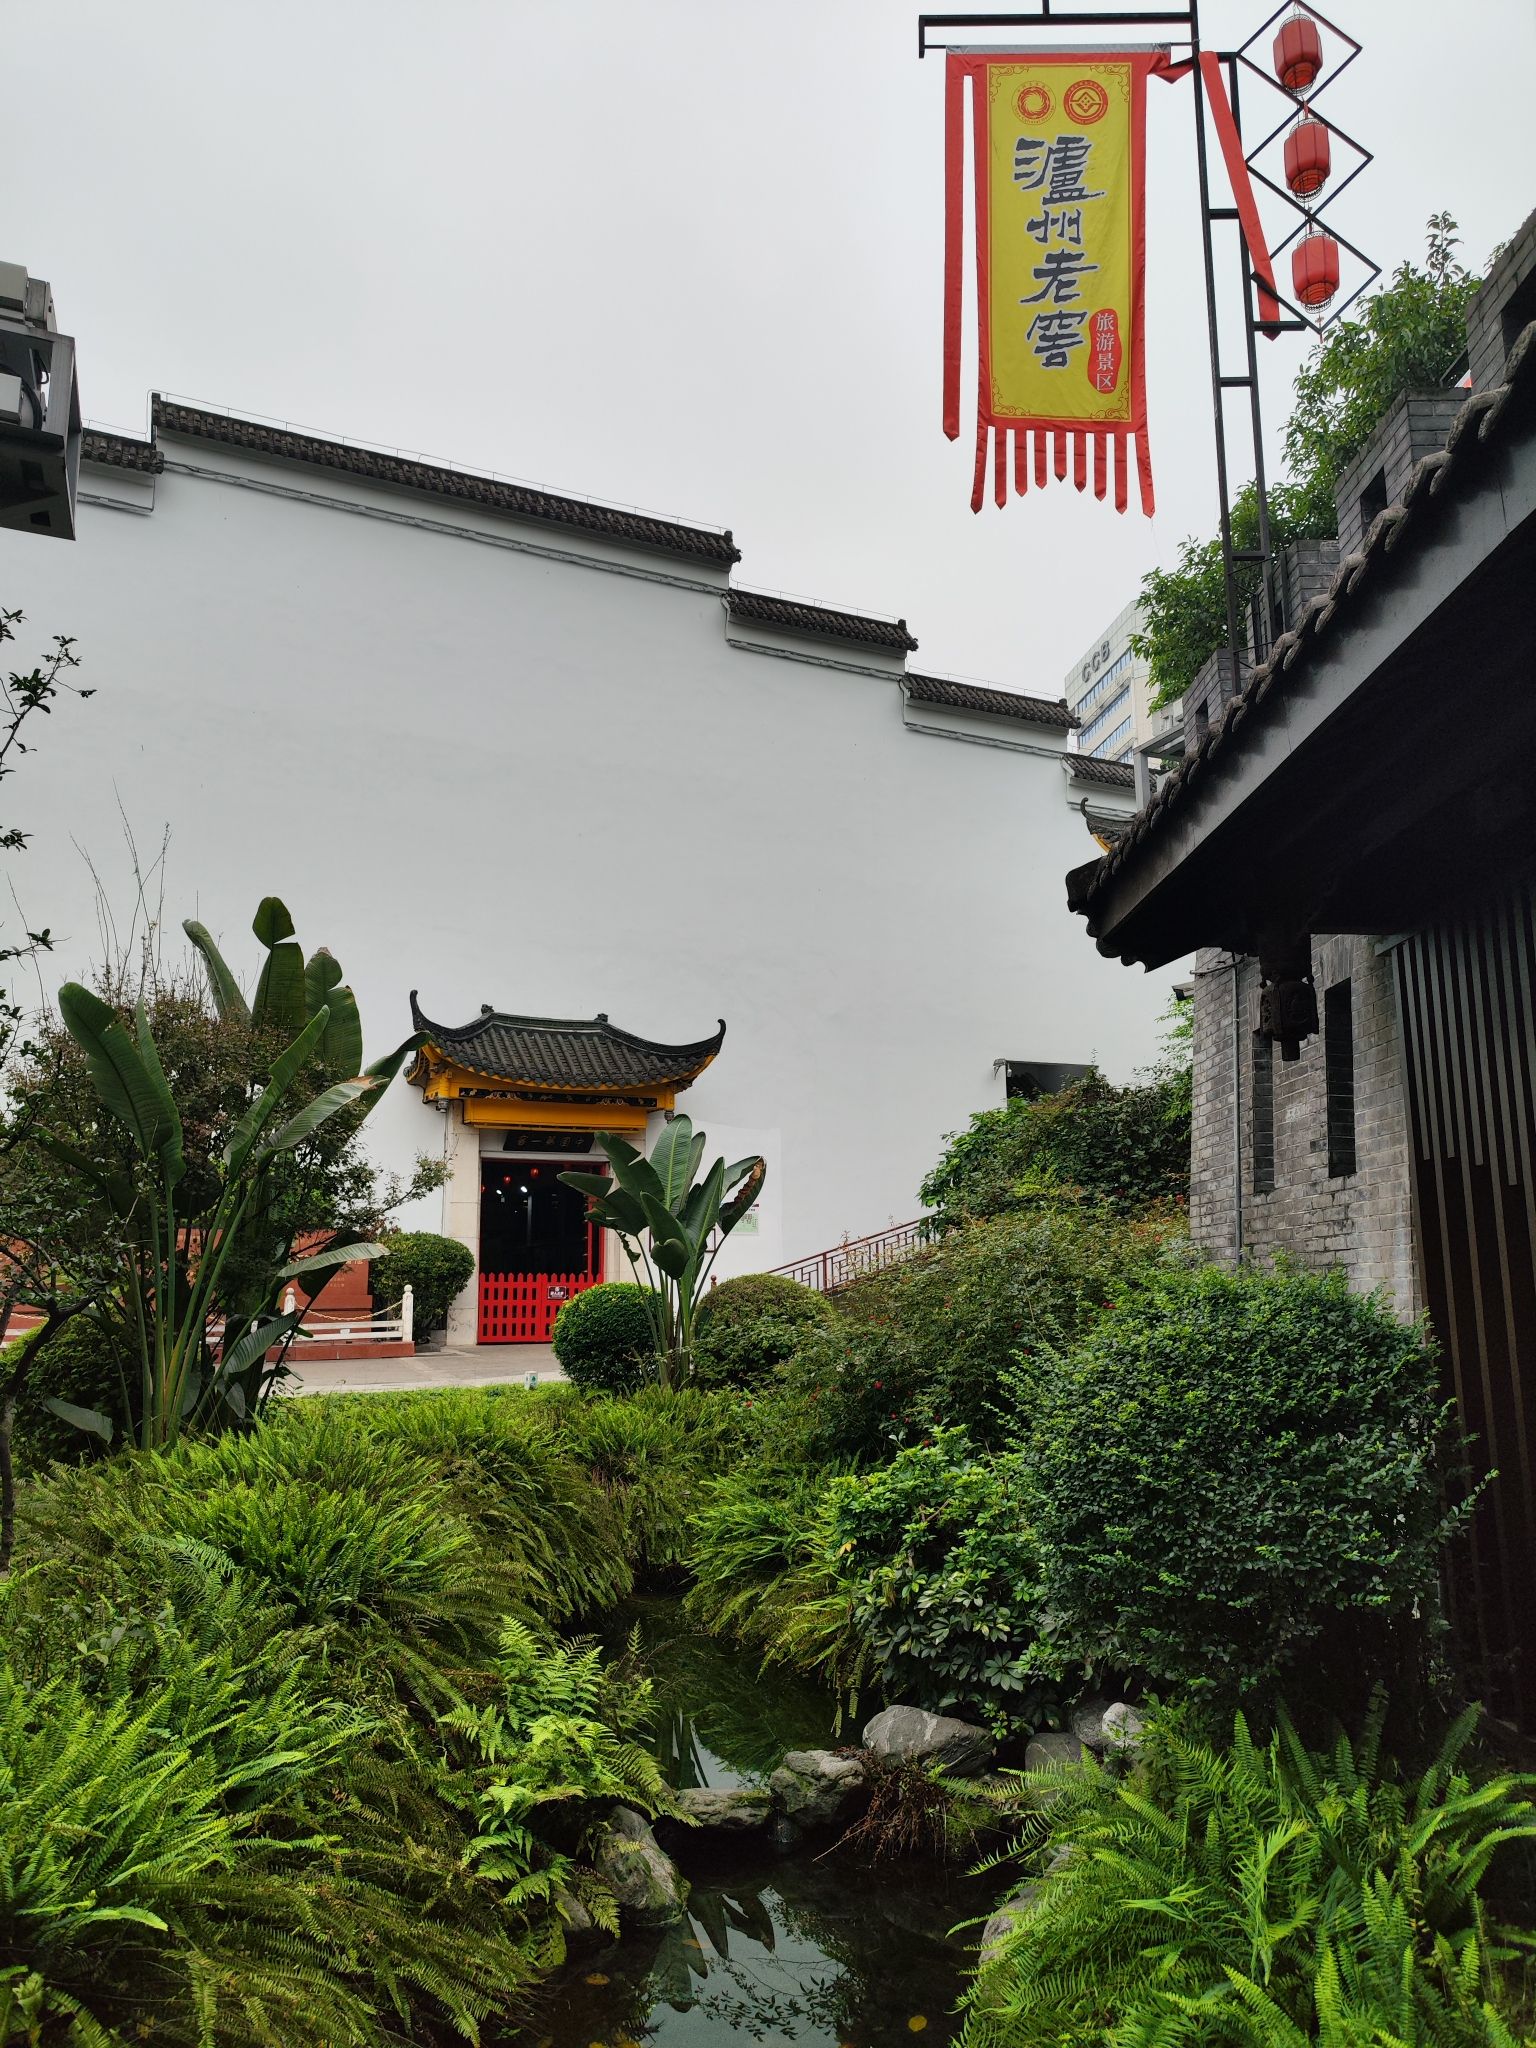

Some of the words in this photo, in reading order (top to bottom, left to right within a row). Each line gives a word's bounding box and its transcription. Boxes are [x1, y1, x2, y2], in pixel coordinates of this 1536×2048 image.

[1096, 312, 1114, 391] 旅游景区
[1081, 640, 1110, 683] CCB
